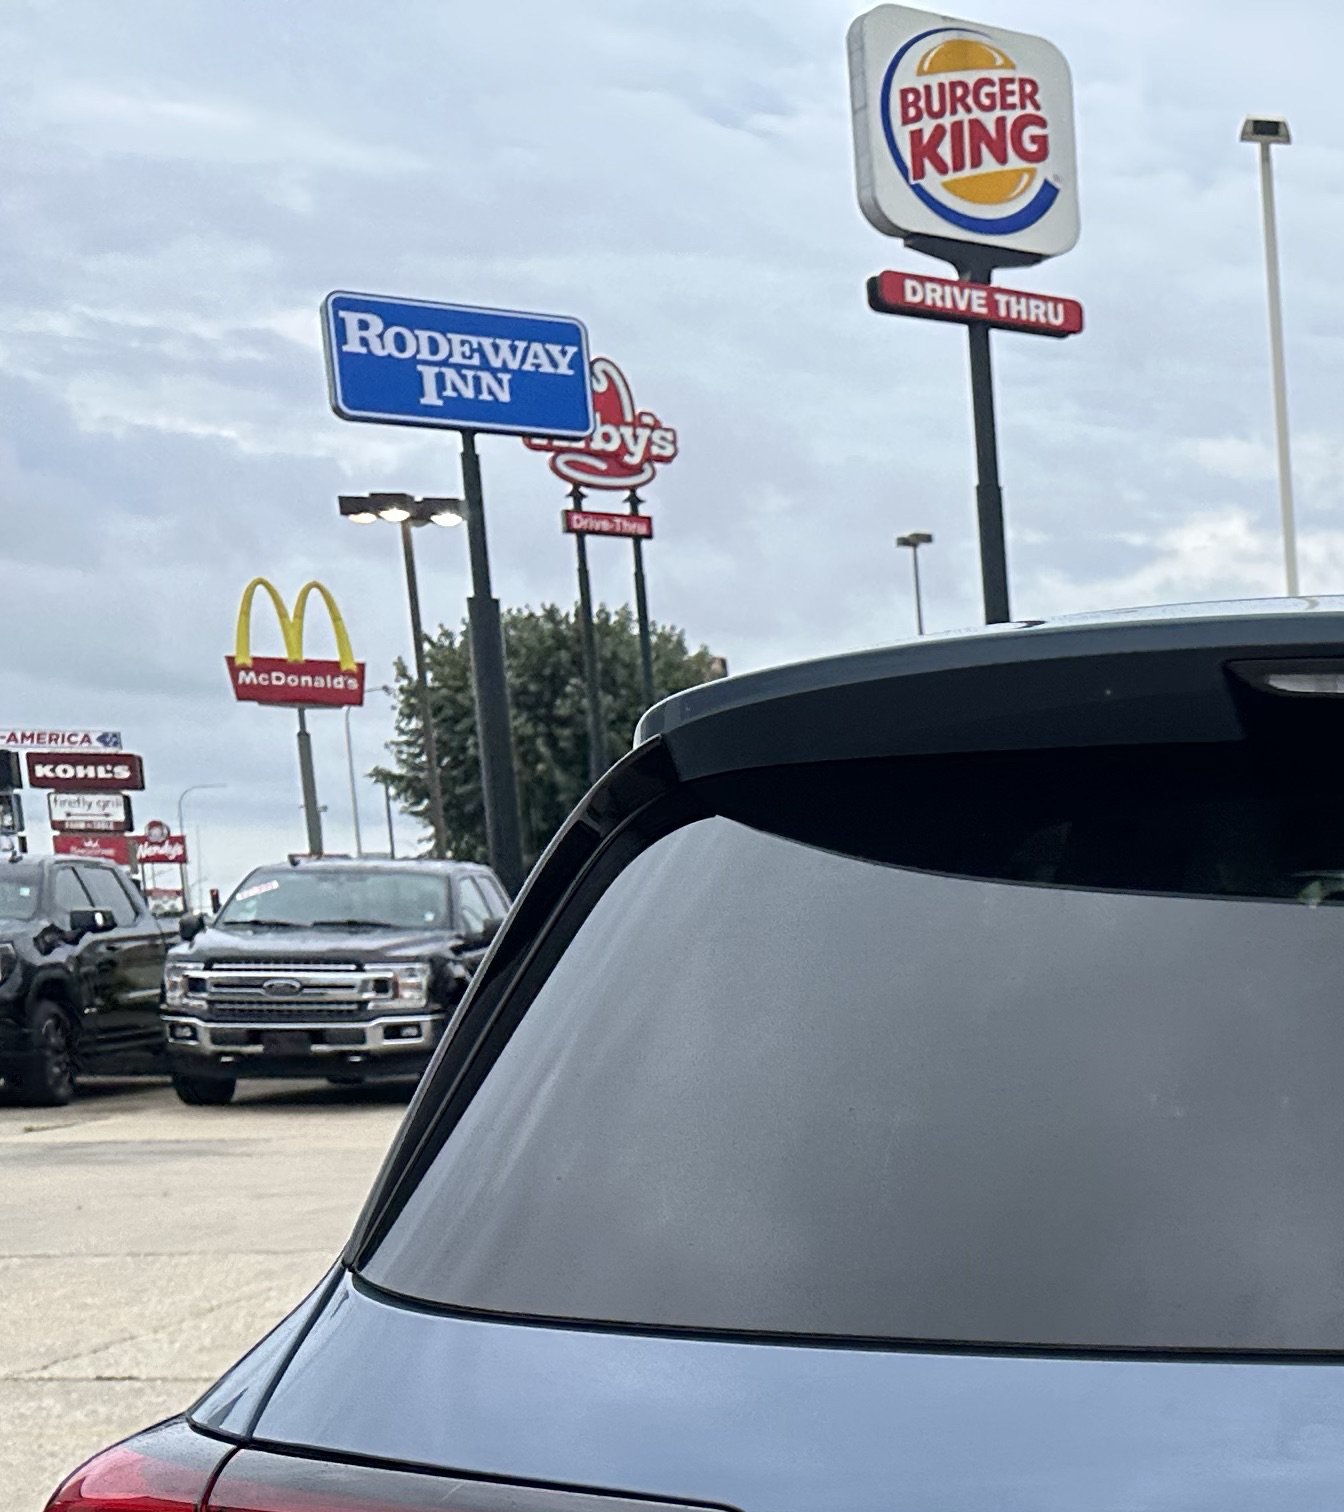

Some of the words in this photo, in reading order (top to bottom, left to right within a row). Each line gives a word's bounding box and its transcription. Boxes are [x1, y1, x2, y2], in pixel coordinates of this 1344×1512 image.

[899, 76, 1042, 127] BURGER
[908, 113, 1050, 182] KING
[903, 278, 989, 315] DRIVE
[993, 292, 1065, 326] THRU
[338, 310, 579, 376] RODEWAY
[416, 364, 512, 407] INN
[530, 411, 676, 465] by's
[238, 669, 359, 690] McDonald's
[34, 763, 131, 779] KOHL'S
